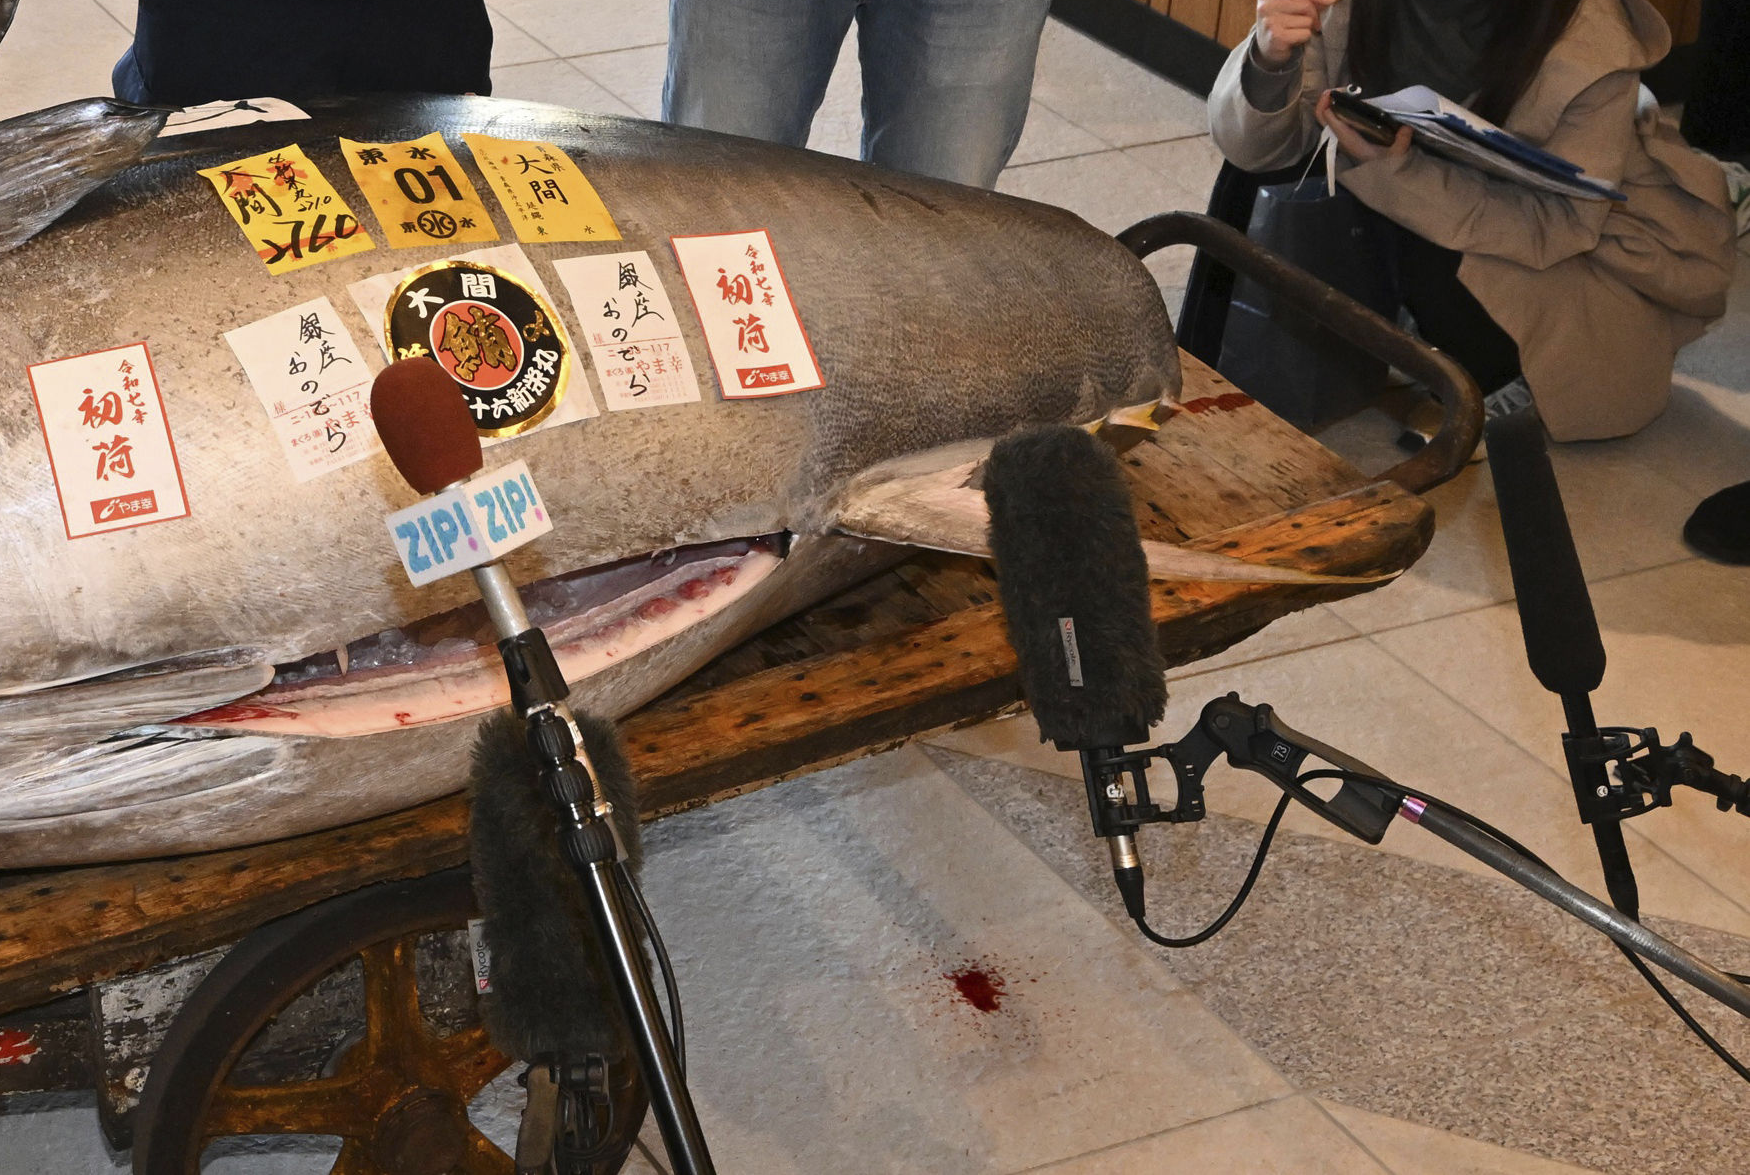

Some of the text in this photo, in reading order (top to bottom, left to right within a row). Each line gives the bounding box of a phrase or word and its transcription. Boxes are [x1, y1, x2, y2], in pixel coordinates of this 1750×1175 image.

[394, 164, 464, 205] 01
[514, 153, 569, 206] 大間
[406, 272, 498, 319] 大間
[716, 267, 771, 354] 初荷
[745, 244, 776, 308] 令和七年
[602, 297, 651, 397] おのでら
[117, 358, 149, 426] 令和七年
[288, 351, 348, 453] おのでら
[463, 348, 559, 421] 十六新栄丸
[78, 387, 136, 482] 初荷
[395, 473, 544, 574] ZIP! ZIP!
[476, 939, 491, 978] Rycote
